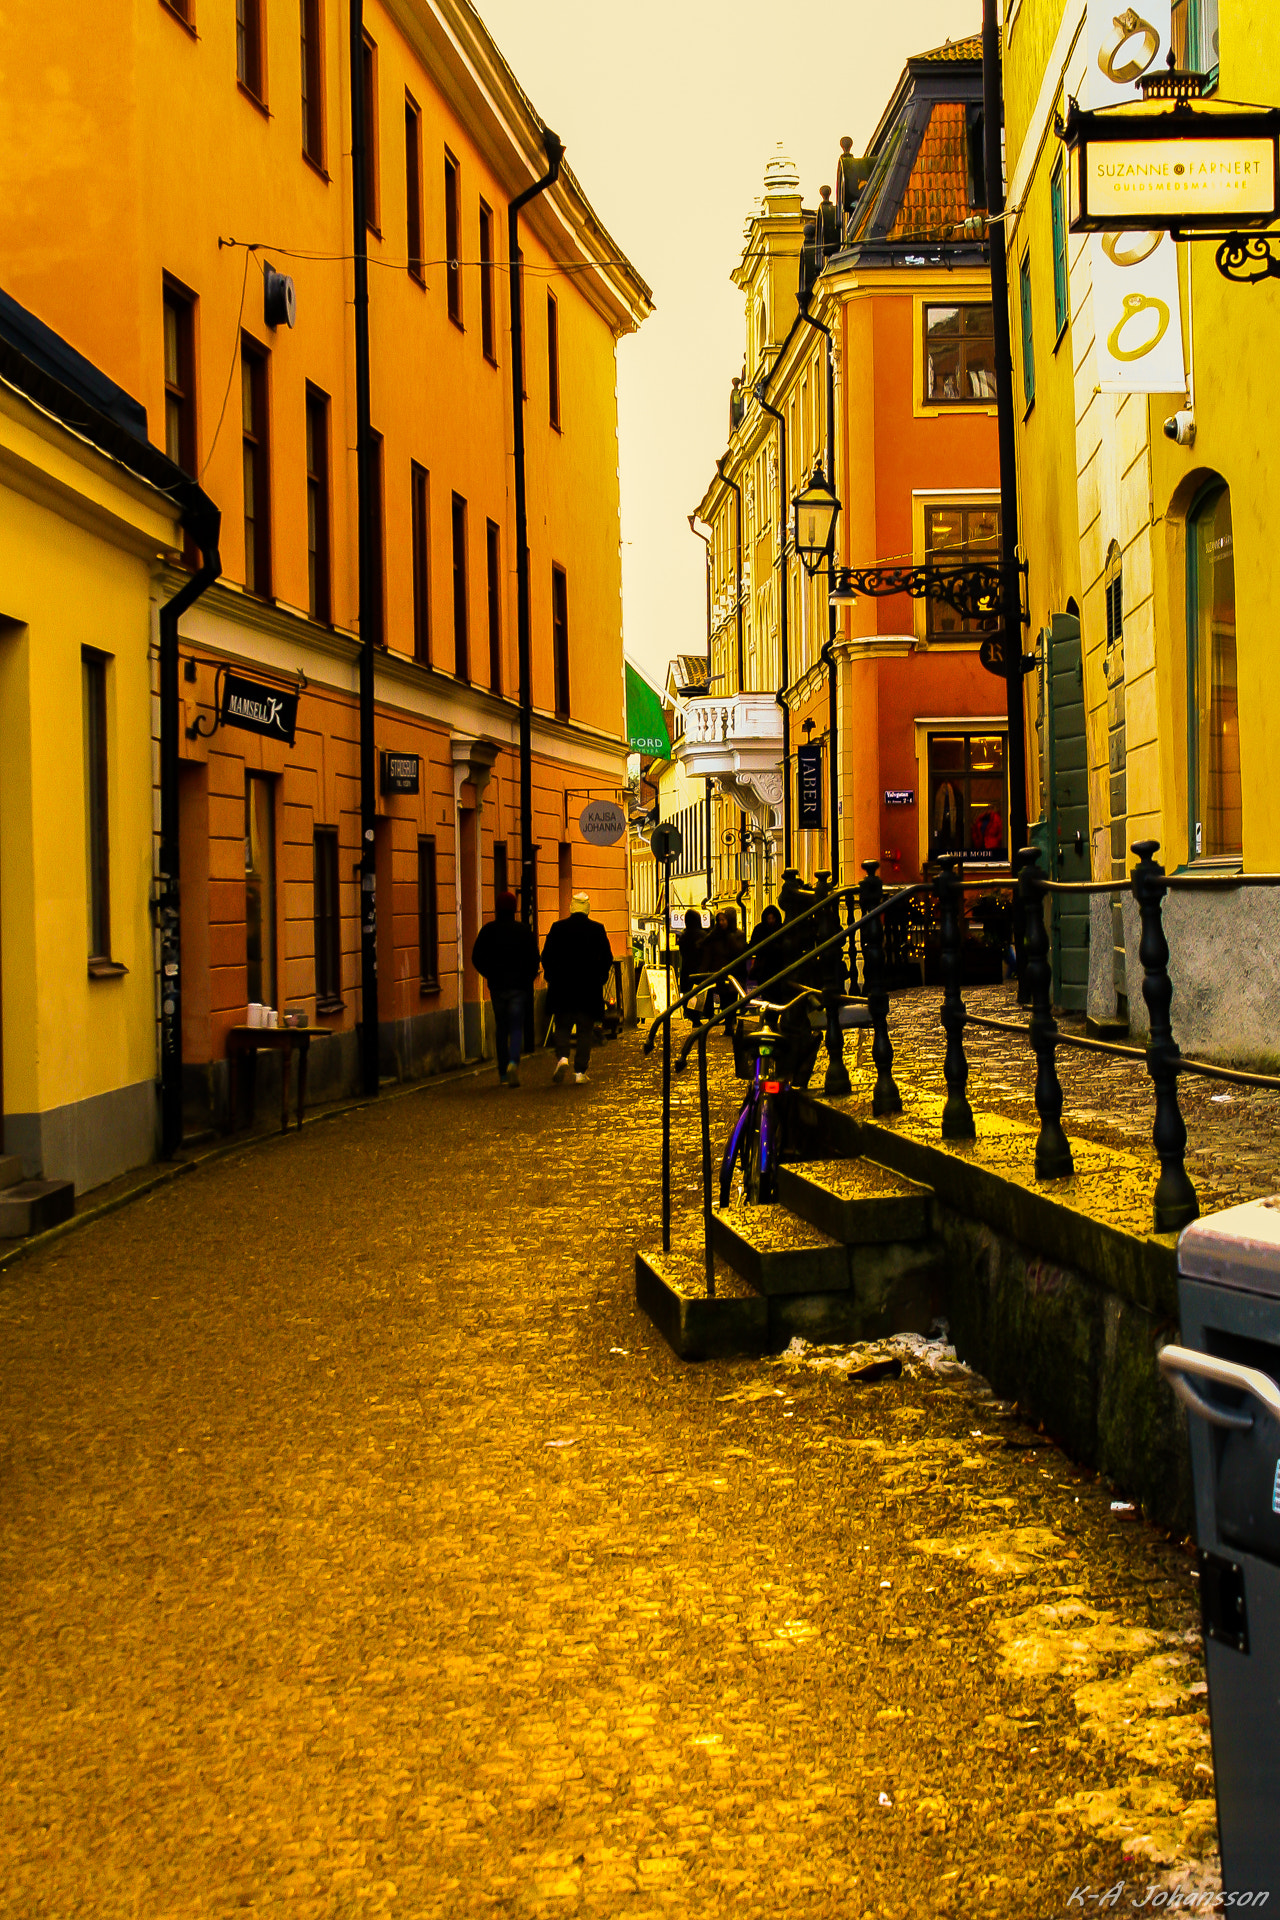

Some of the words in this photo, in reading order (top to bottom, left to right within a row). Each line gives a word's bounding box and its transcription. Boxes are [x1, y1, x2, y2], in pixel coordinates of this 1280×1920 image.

[1097, 163, 1169, 177] SUZANNE
[229, 694, 268, 721] MAMSELL
[267, 697, 289, 733] K
[800, 757, 817, 813] JABER
[588, 811, 617, 821] KAJSA
[582, 822, 623, 832] JOHANNA
